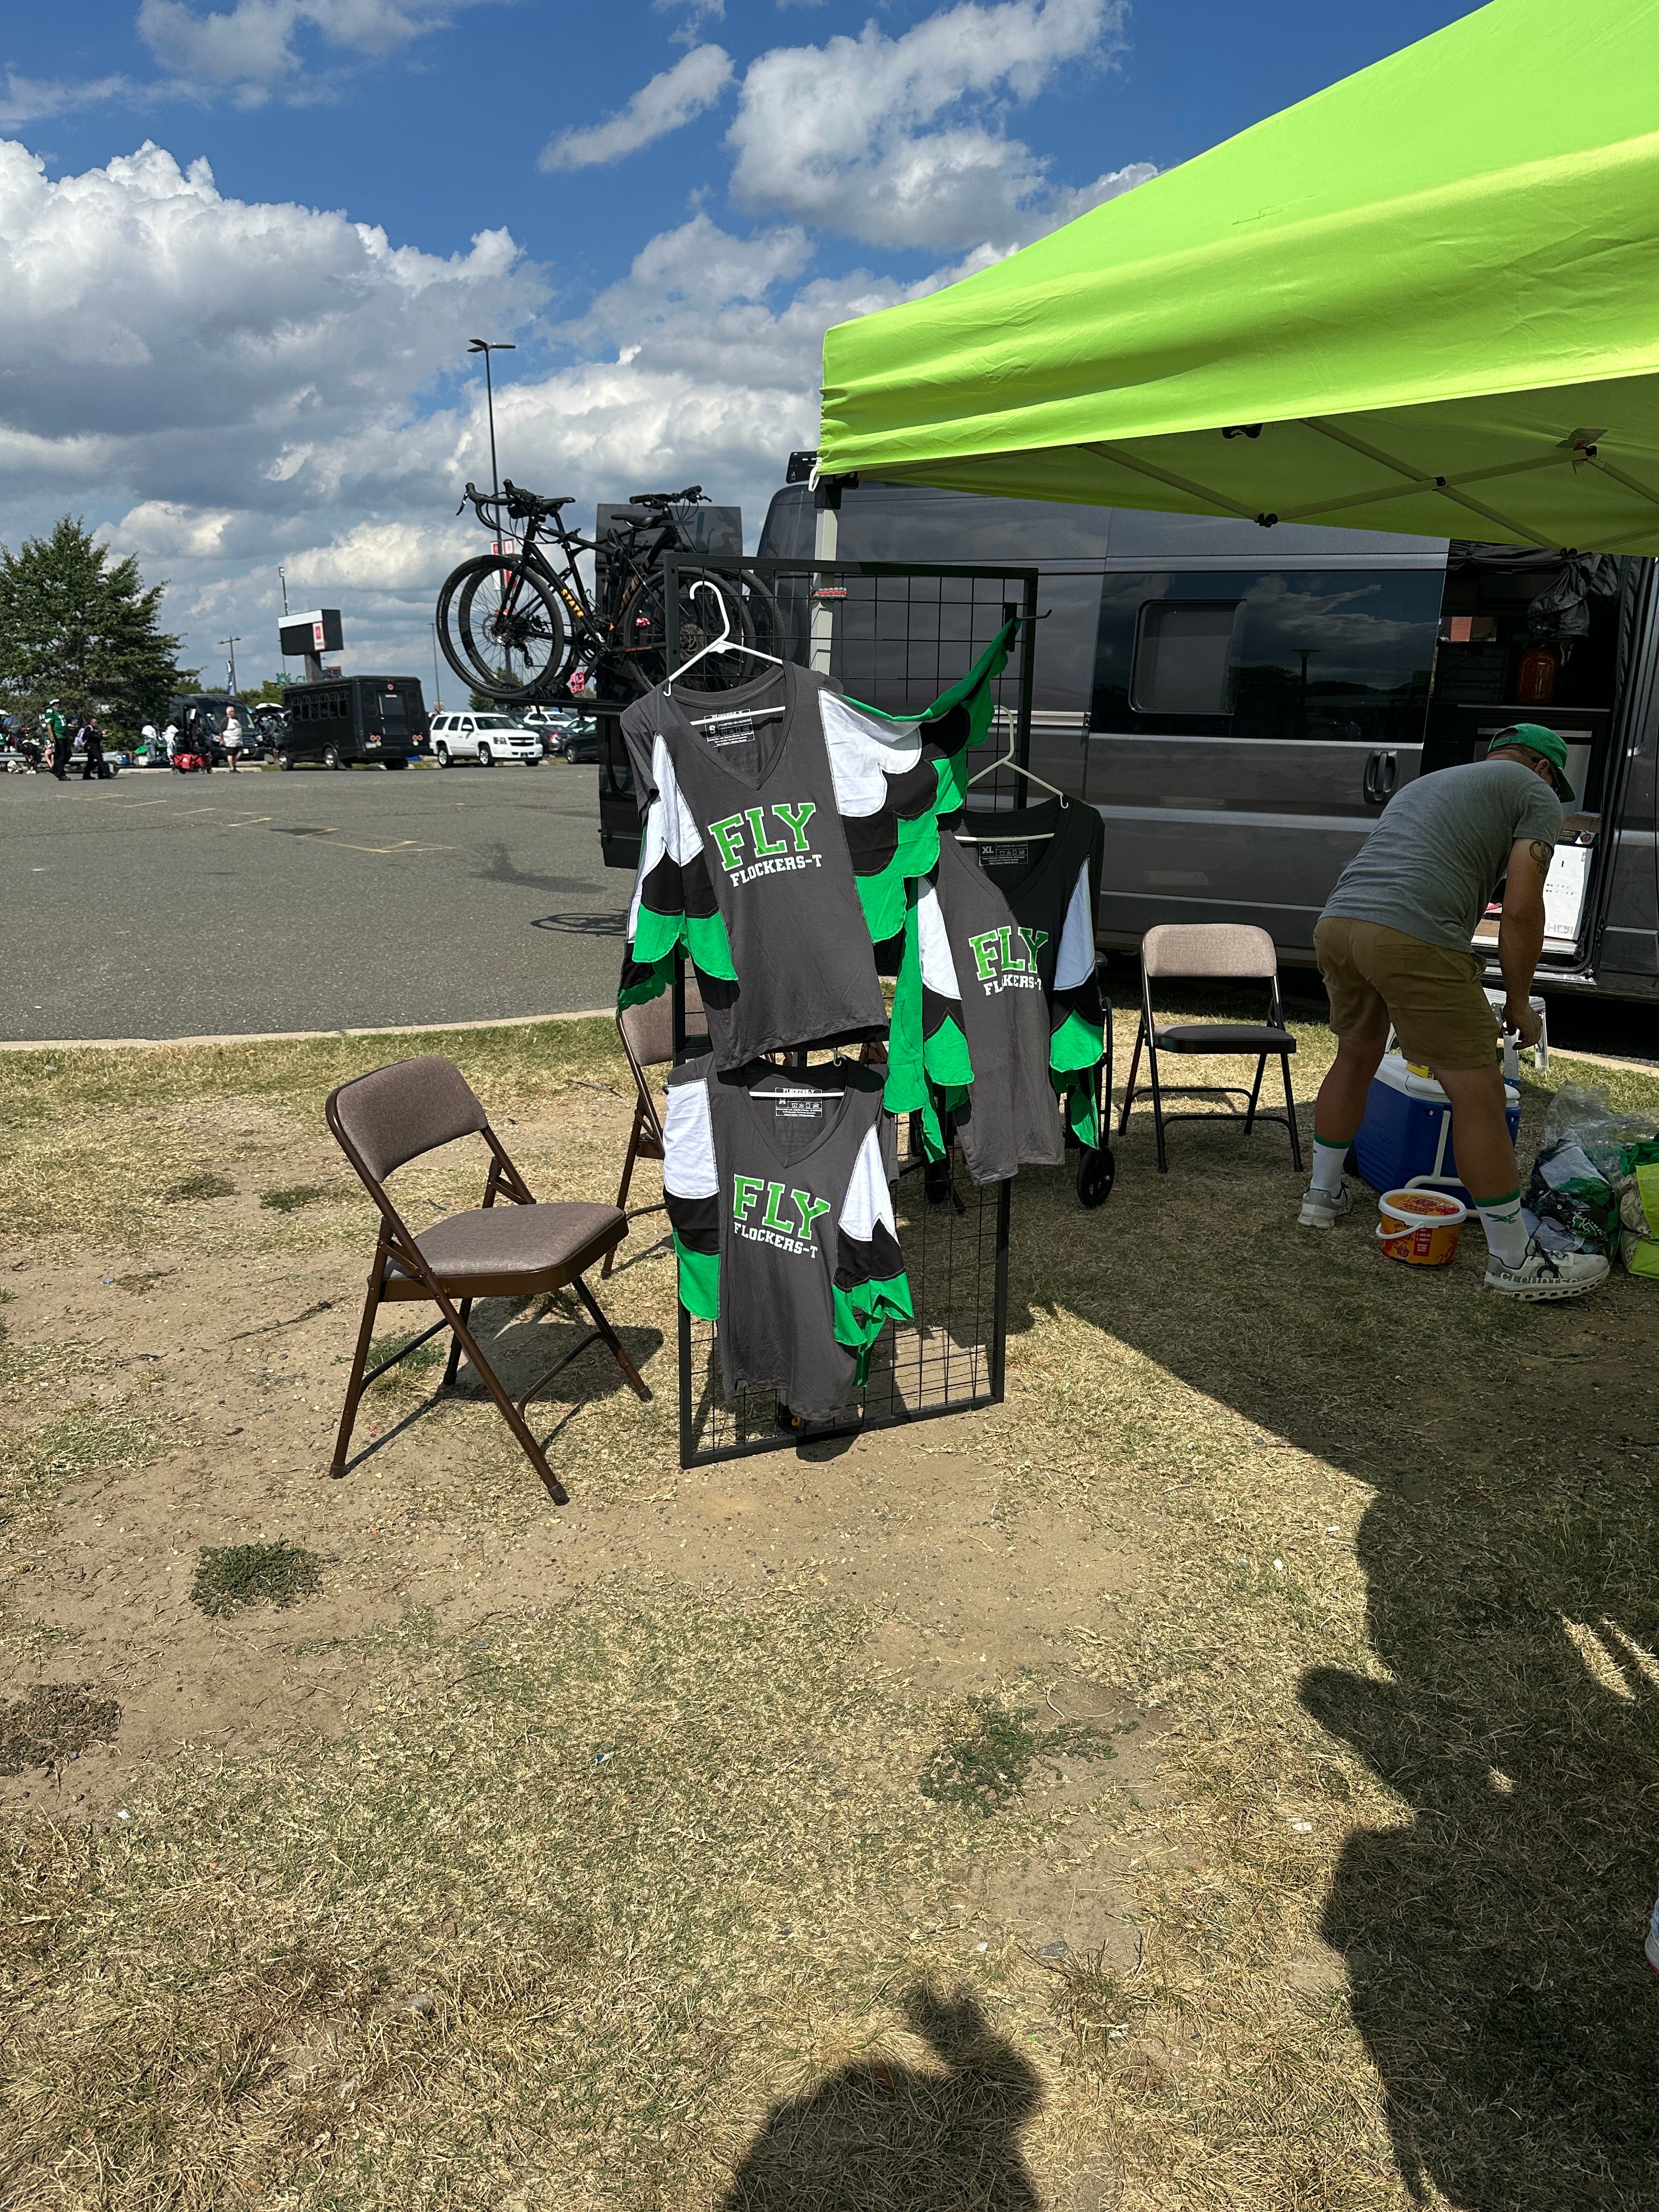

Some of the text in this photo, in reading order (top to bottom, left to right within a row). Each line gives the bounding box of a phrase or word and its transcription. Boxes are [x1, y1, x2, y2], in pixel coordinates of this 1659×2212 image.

[561, 589, 584, 618] STATE
[707, 803, 816, 872] FLY
[730, 854, 822, 887] FLOCKERS-T
[968, 926, 1048, 981] FLY
[983, 974, 1041, 996] FLKERS-T
[733, 1173, 831, 1240] FLY
[734, 1222, 817, 1258] FLOCKERS-T
